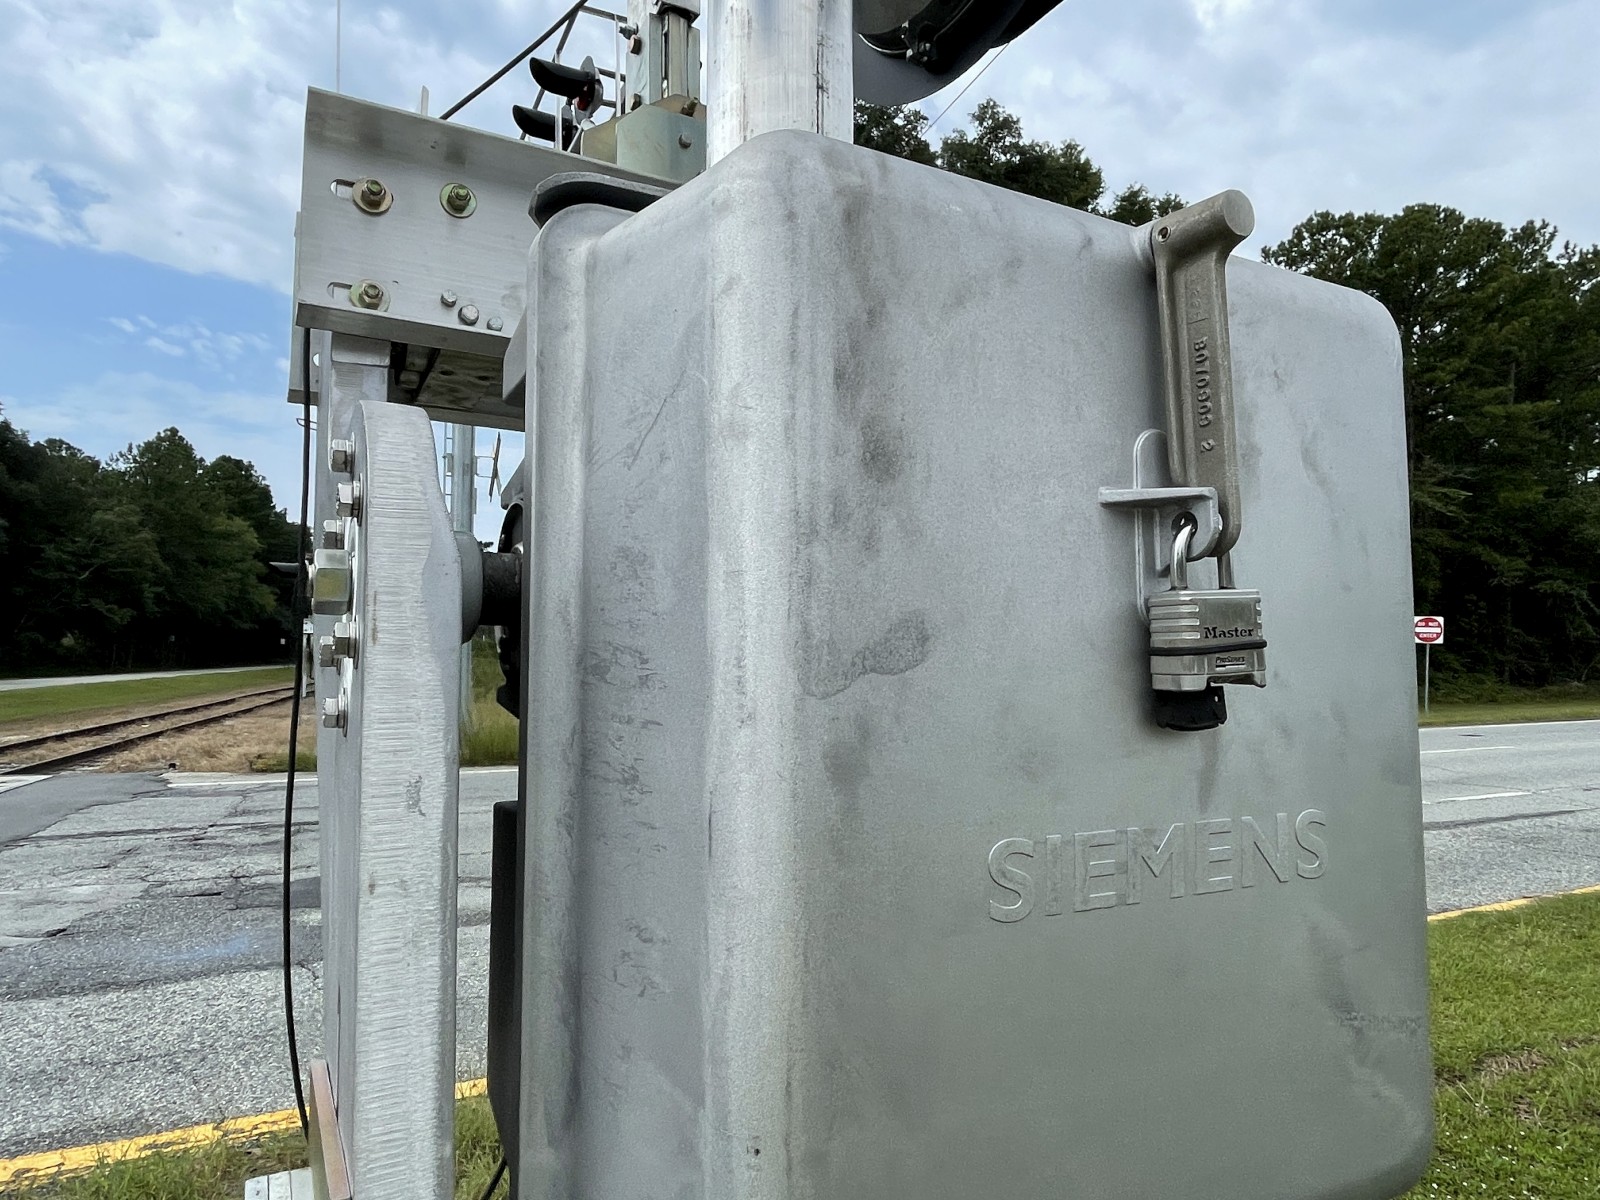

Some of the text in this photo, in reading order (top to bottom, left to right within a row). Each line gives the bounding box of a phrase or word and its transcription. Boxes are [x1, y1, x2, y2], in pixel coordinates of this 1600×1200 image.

[1201, 439, 1216, 454] 2
[1203, 626, 1255, 639] Master
[988, 808, 1329, 923] SIEMENS
